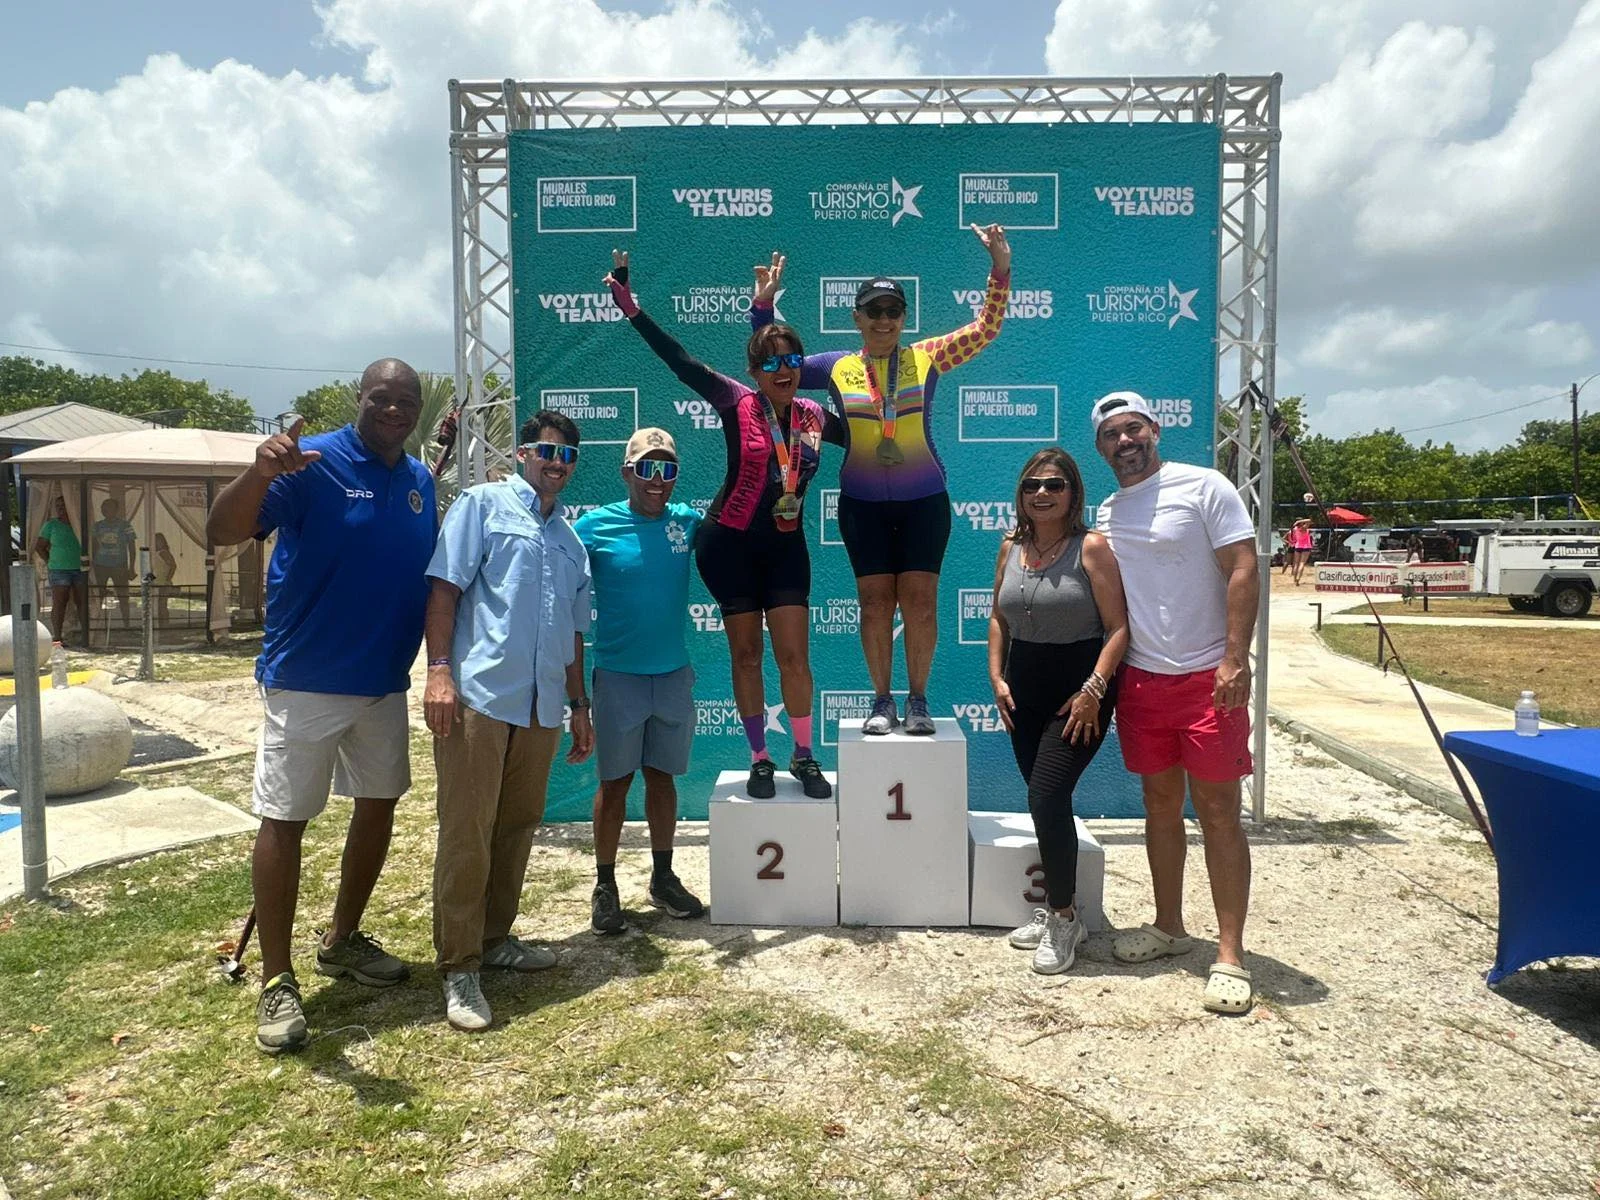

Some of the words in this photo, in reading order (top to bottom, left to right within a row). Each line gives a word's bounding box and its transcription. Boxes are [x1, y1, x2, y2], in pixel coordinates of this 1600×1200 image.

[543, 182, 587, 194] MURALES
[826, 182, 874, 191] COMPAÑÍA
[877, 183, 888, 191] DE
[965, 179, 1009, 191] MURALES
[542, 195, 555, 207] DE
[556, 195, 593, 207] PUERTO
[594, 194, 616, 207] RICO
[808, 191, 889, 208] TURISMO
[964, 191, 977, 204] DE
[978, 191, 1015, 204] PUERTO
[1016, 191, 1038, 204] RICO
[689, 202, 773, 217] TEANDO
[814, 209, 857, 220] PUERTO
[861, 209, 890, 220] RICO
[1111, 201, 1194, 216] TEANDO
[689, 286, 737, 295] COMPAÑÍA
[739, 287, 752, 295] DE
[826, 282, 862, 295] MURAL
[1103, 285, 1151, 294] COMPAÑÍA
[1153, 286, 1166, 294] DE
[671, 295, 752, 313] TURISMO
[825, 295, 838, 308] DE
[1086, 294, 1166, 312] TURISMO
[555, 308, 629, 323] TEAND
[677, 313, 720, 324] PUERTO
[1091, 312, 1134, 322] PUERTO
[1138, 312, 1166, 322] RICO
[546, 394, 590, 407] MURALES
[964, 391, 1009, 404] MURALES
[559, 406, 596, 420] PUERTO
[596, 406, 619, 419] RICO
[673, 400, 712, 416] VOY
[963, 404, 977, 417] DE
[978, 404, 1015, 417] PUERTO
[1015, 404, 1038, 417] RICO
[951, 501, 1017, 517] VOYTU
[1550, 546, 1599, 557] Allmand
[826, 598, 860, 607] COMPA
[964, 594, 994, 607] MURA
[809, 606, 861, 623] TURIS
[963, 606, 976, 619] DE
[815, 624, 858, 634] PUERTO
[826, 695, 871, 708] MURALES
[826, 708, 838, 721] DE
[694, 725, 723, 736] ERTO
[726, 725, 745, 736] RIC
[968, 718, 1007, 732] TEA
[886, 782, 912, 821] 1
[756, 841, 785, 880] 2
[1022, 863, 1048, 903] 3
